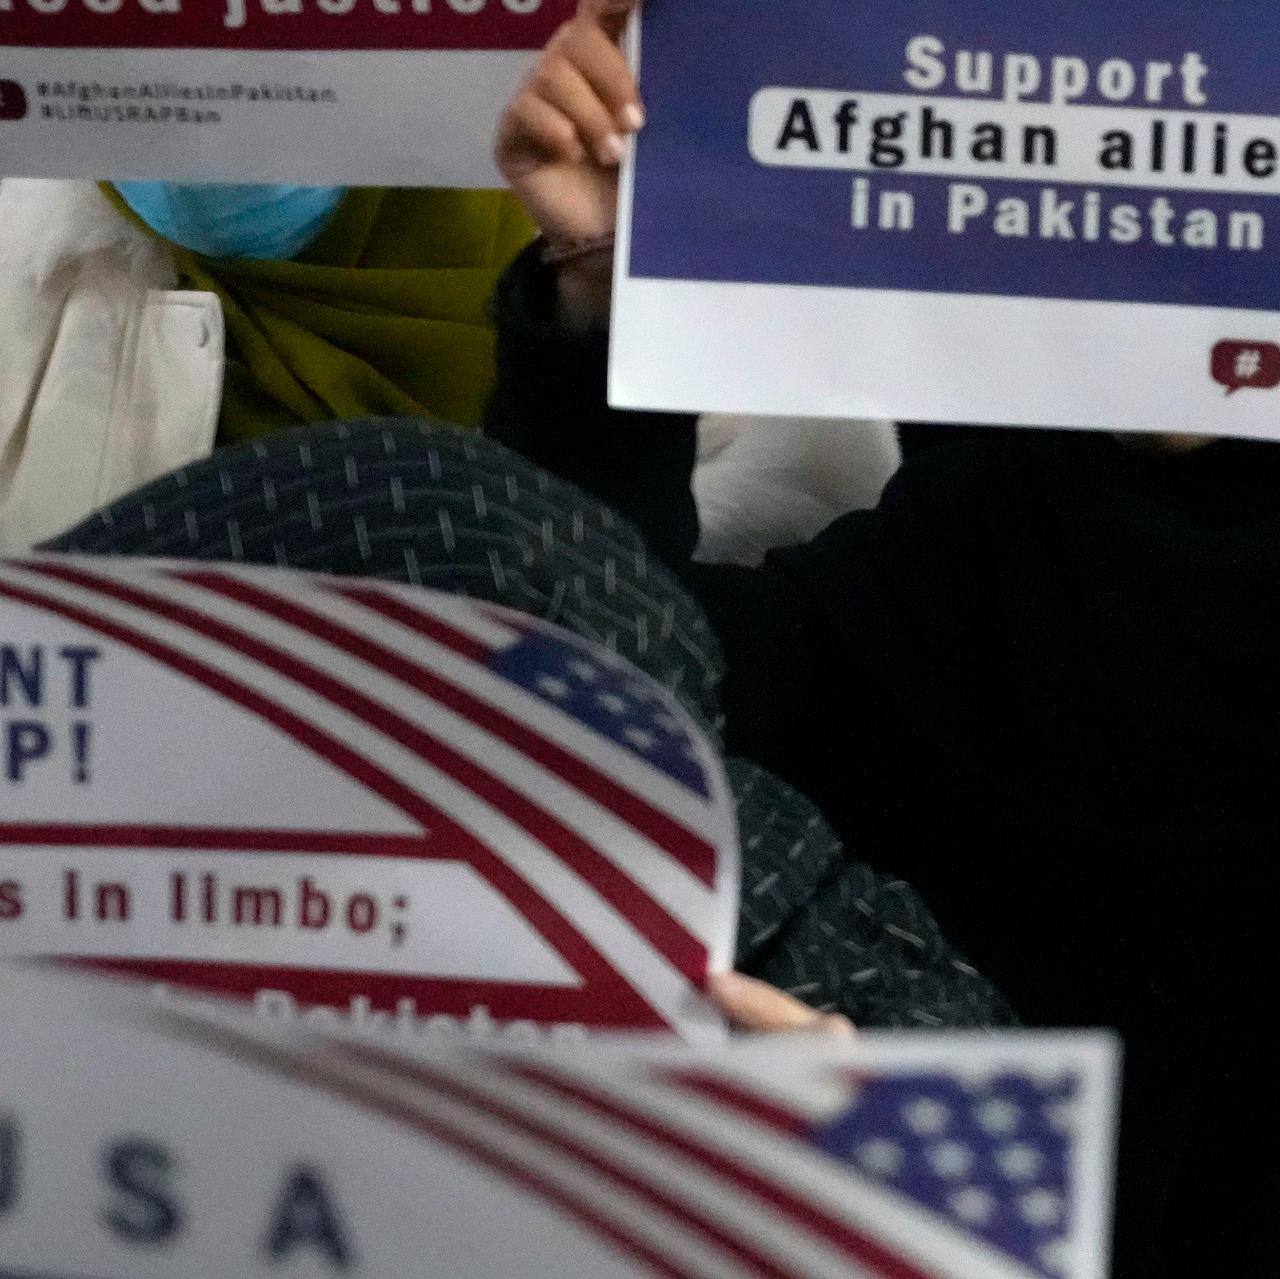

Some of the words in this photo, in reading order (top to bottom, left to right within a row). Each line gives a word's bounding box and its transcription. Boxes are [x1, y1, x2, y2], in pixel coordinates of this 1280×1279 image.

[902, 33, 1209, 109] Support
[774, 96, 1060, 172] Afghan
[849, 177, 916, 231] in
[947, 188, 1266, 252] Pakistan
[7, 721, 93, 783] P!
[63, 870, 130, 922] in
[170, 871, 411, 947] limbo;
[0, 1115, 358, 1270] SA
